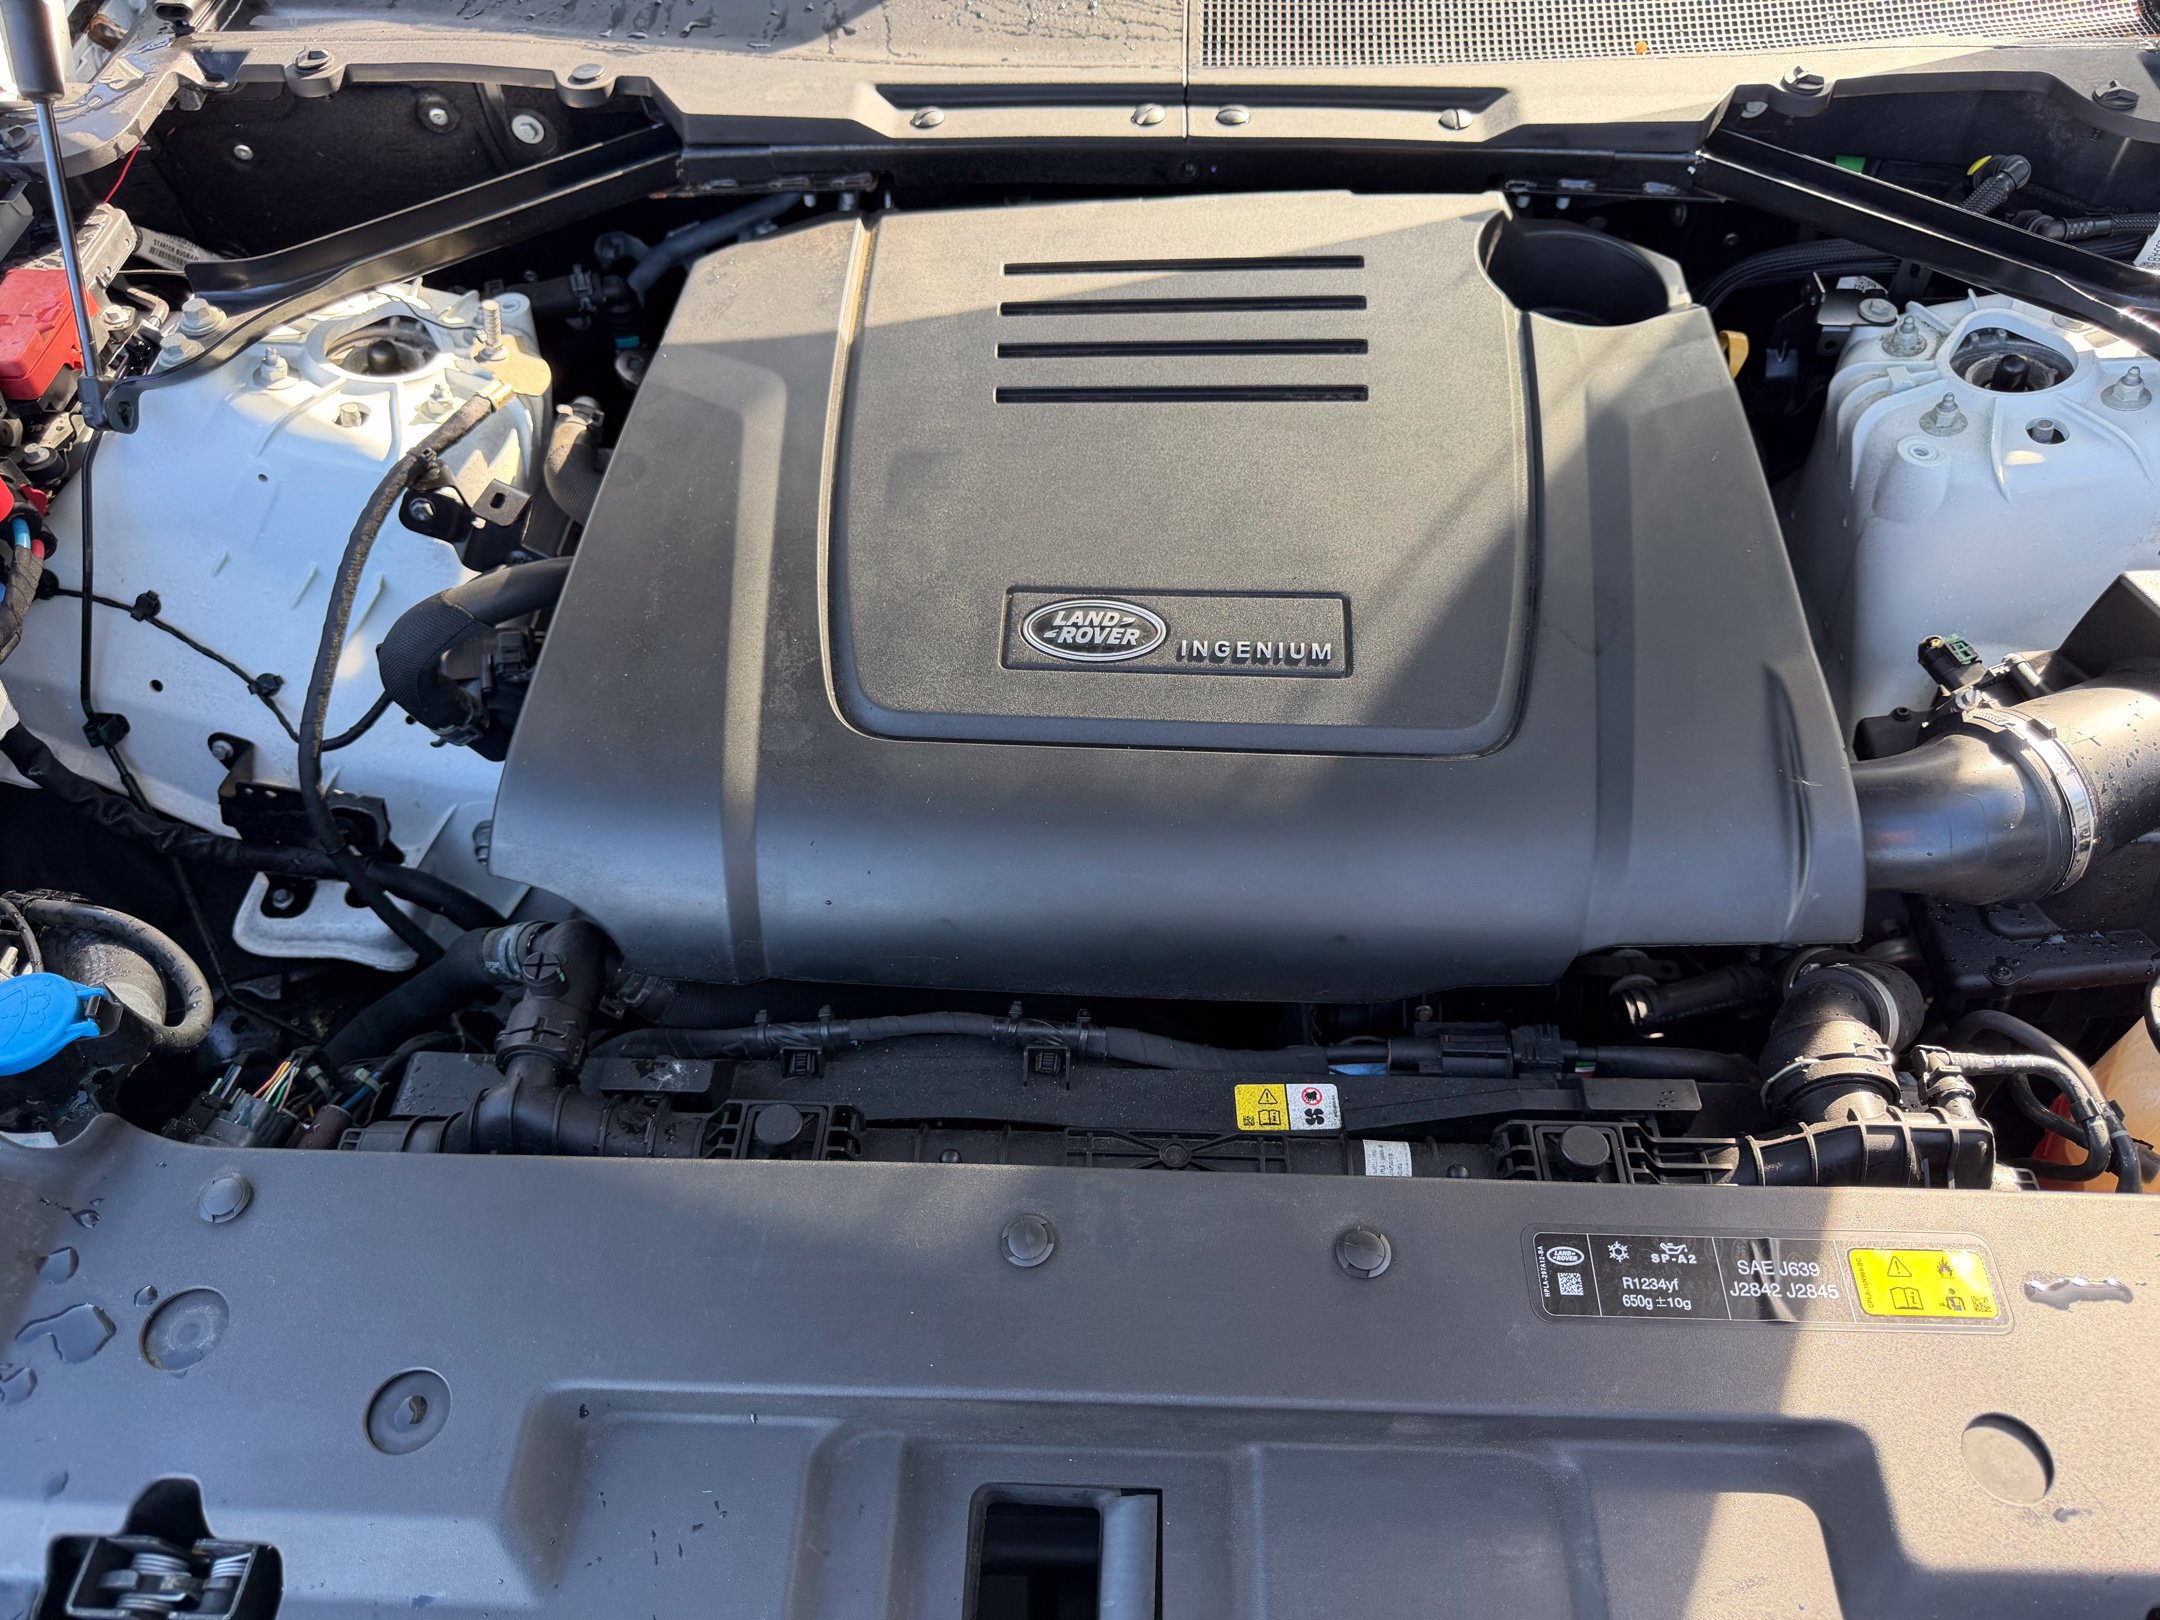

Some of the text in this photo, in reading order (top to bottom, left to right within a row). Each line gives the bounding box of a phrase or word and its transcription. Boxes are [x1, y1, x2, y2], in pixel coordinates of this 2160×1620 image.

[1052, 610, 1120, 627] LAND
[1057, 627, 1140, 646] ROVER
[1180, 639, 1332, 660] INGENIUM
[1651, 1253, 1697, 1264] SP-A2
[1737, 1259, 1821, 1277] SAE J639
[1623, 1277, 1679, 1293] R1234yf
[1729, 1282, 1840, 1300] J2842 J2845
[1622, 1295, 1692, 1310] 650g ±10g
